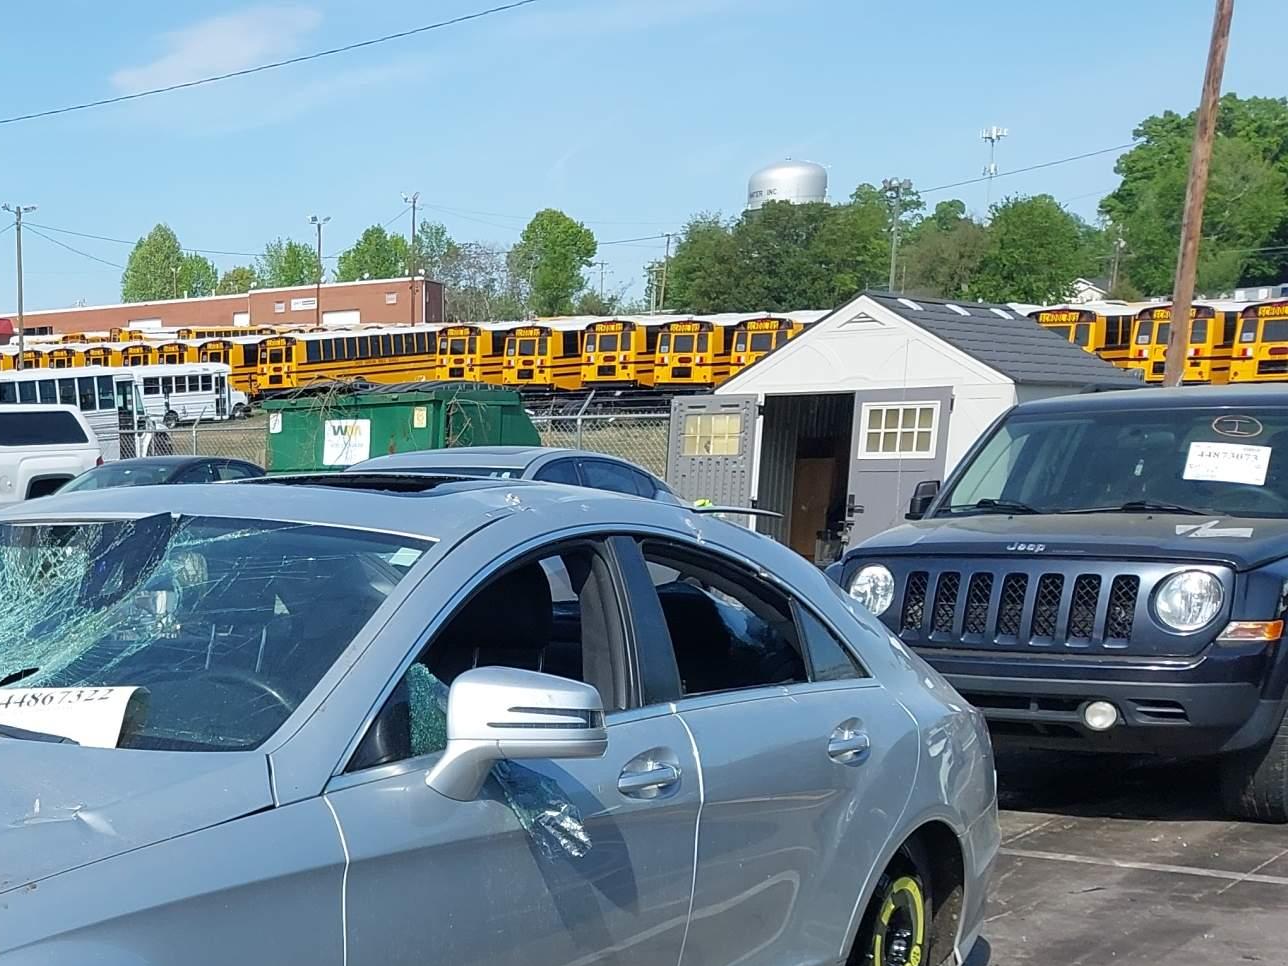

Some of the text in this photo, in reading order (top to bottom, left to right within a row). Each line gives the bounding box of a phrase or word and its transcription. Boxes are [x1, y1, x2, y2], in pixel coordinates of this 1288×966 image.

[332, 425, 361, 438] WM
[1006, 542, 1046, 553] Jeep
[0, 688, 115, 709] 44867322
